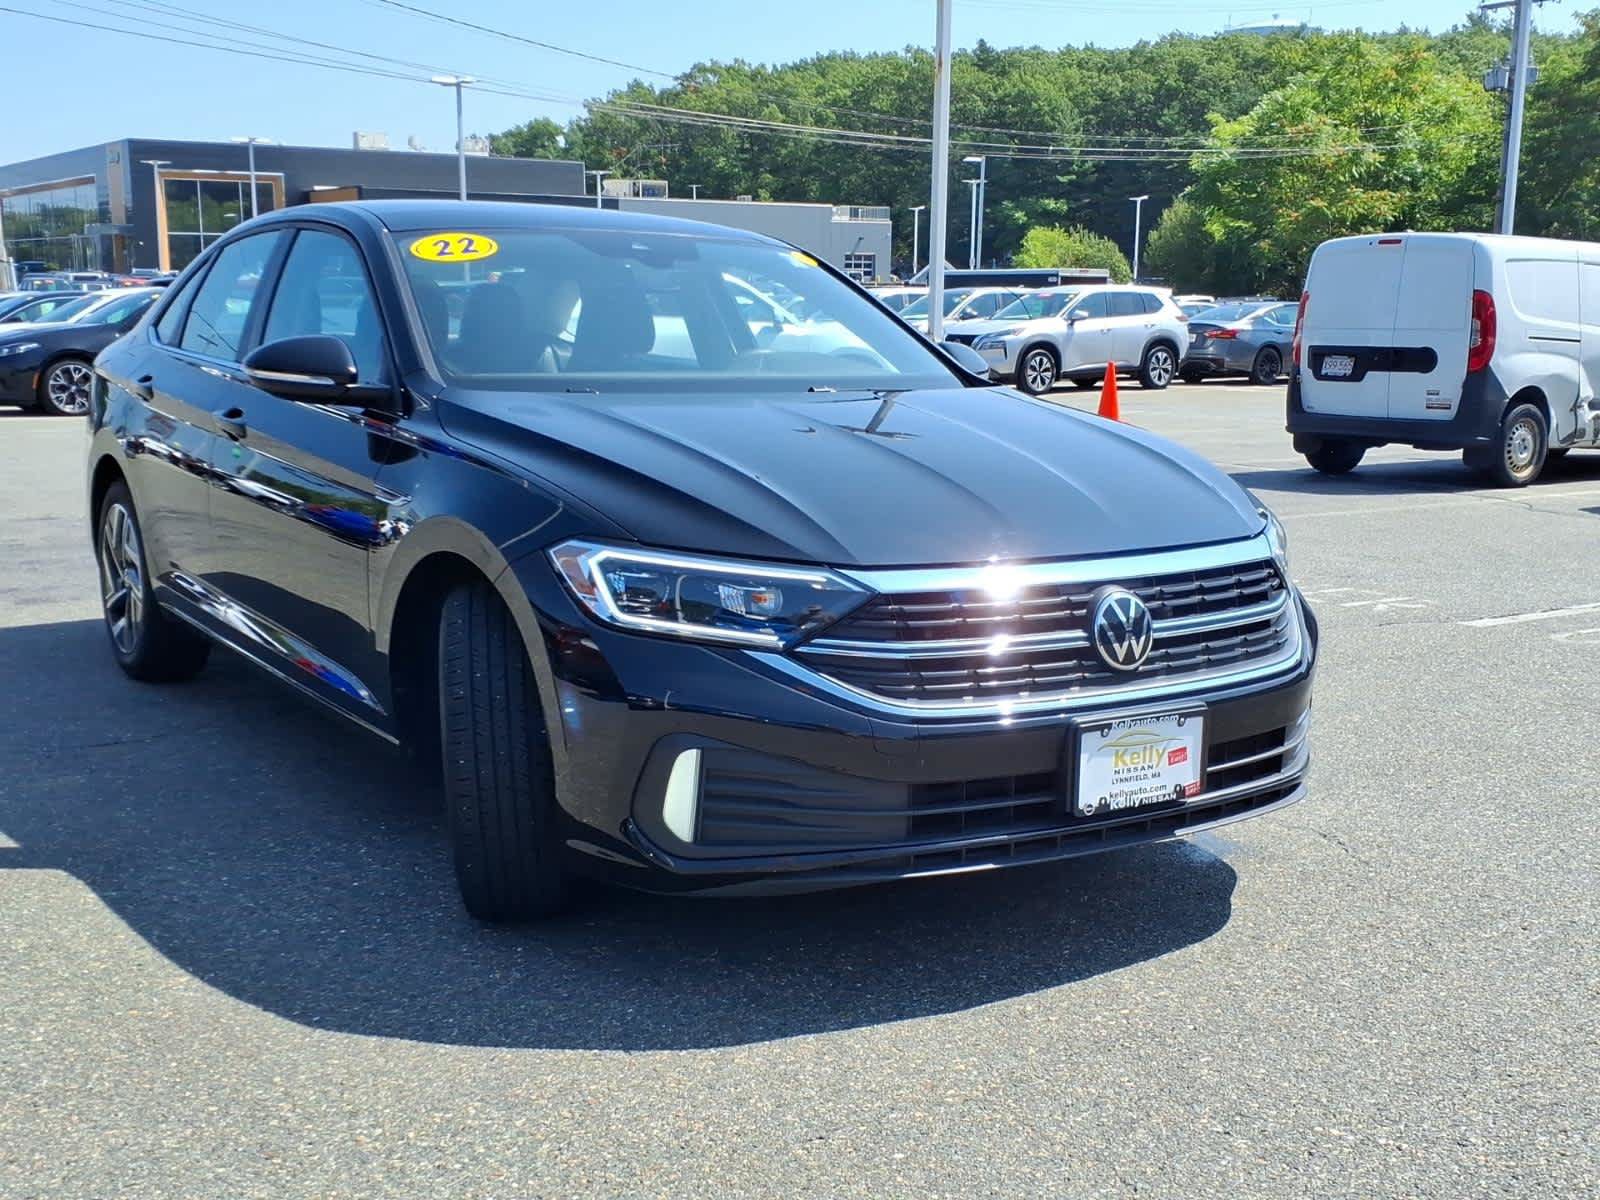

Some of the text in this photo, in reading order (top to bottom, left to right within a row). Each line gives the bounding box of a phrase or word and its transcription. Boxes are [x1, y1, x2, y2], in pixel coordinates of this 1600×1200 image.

[432, 237, 479, 256] 22
[1113, 744, 1166, 768] Kelly
[1114, 764, 1154, 775] NISSAN
[1109, 784, 1167, 799] kellyauto.com
[1110, 793, 1177, 810] Kelly NISSAN
